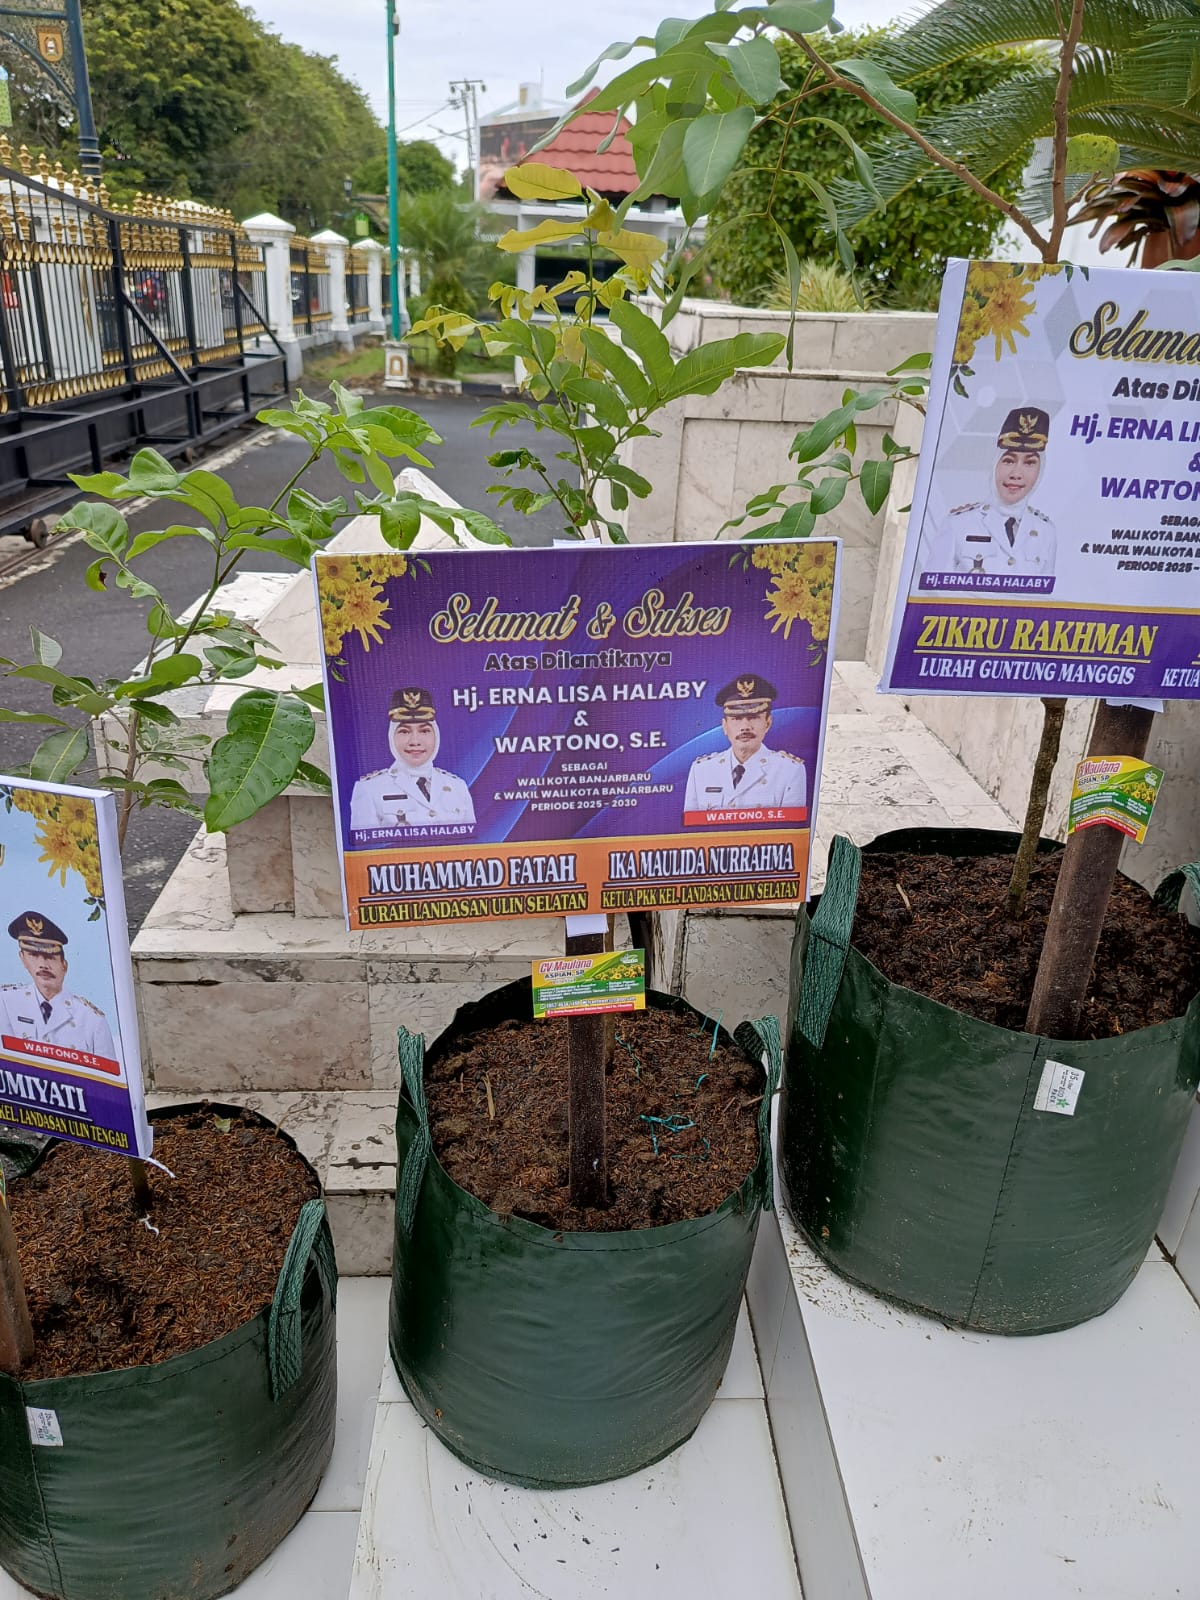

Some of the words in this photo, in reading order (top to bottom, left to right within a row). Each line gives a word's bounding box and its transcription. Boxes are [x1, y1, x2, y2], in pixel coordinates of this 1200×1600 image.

[1069, 300, 1200, 365] Selama
[1112, 377, 1170, 400] Atas
[1070, 413, 1102, 444] Hj.
[1107, 417, 1173, 441] ERNA
[1178, 421, 1200, 442] LI
[1160, 515, 1200, 527] SEBAG
[1111, 529, 1140, 541] WALI
[1141, 530, 1173, 542] KOTA
[1081, 543, 1090, 553] &
[1092, 543, 1130, 555] WAKIL
[1132, 545, 1161, 556] WALI
[1161, 546, 1193, 558] KOTA
[1117, 560, 1164, 572] PERIODE
[1164, 561, 1193, 573] 2025
[926, 574, 941, 587] Hj.
[942, 575, 974, 586] ERNA
[976, 576, 1001, 587] LISA
[1002, 577, 1050, 589] HALABY
[429, 592, 582, 643] Selamat
[586, 602, 616, 639] &
[623, 588, 732, 639] Sukses
[916, 615, 1009, 650] ZIKRU
[1009, 618, 1159, 657] RAKHMAN
[484, 652, 538, 672] Atas
[541, 648, 672, 673] Dilantiknya
[919, 657, 977, 678] LURAH
[979, 659, 1057, 682] GUNTUNG
[1057, 663, 1136, 685] MANGGIS
[1160, 668, 1200, 688] KETUA
[453, 686, 484, 712] Hj.
[489, 687, 553, 706] ERNA
[558, 685, 607, 703] LISA
[612, 681, 707, 701] HALABY
[573, 709, 589, 727] &
[494, 733, 624, 753] WARTONO,
[630, 731, 667, 749] S.E.
[561, 762, 608, 772] SEBAGAI
[517, 777, 545, 787] WALI
[547, 776, 577, 786] KOTA
[579, 773, 651, 784] BANJARBARU
[494, 792, 502, 801] &
[504, 791, 538, 800] WAKIL
[541, 789, 568, 798] WALI
[570, 788, 600, 797] KOTA
[602, 784, 673, 795] BANJARBARU
[531, 801, 575, 811] PERIODE
[577, 800, 602, 809] 2025
[612, 799, 637, 808] 2030
[706, 811, 766, 822] WARTONO,
[767, 810, 786, 819] S.E.
[355, 831, 370, 842] Hj.
[372, 828, 402, 839] ERNA
[404, 827, 428, 837] LISA
[430, 825, 475, 836] HALABY
[609, 851, 637, 880] IKA
[639, 848, 706, 878] MAULIDA
[708, 843, 794, 875] NURRAHMA
[368, 858, 505, 895] MUHAMMAD
[508, 854, 576, 886] FATAH
[602, 890, 634, 908] KETUA
[636, 888, 657, 906] PKK
[659, 886, 680, 905] KEL.
[681, 884, 731, 904] LANDASAN
[733, 882, 755, 900] ULIN
[757, 880, 799, 899] SELATAN
[360, 903, 410, 924] LURAH
[413, 898, 489, 920] LANDASAN
[491, 895, 524, 915] ULIN
[526, 892, 588, 913] SELATAN
[24, 1042, 82, 1063] WARTONO,
[83, 1055, 100, 1067] S.E.
[19, 1108, 67, 1134] LANDASAN
[69, 1119, 90, 1139] ULIN
[90, 1125, 128, 1148] TENGAH
